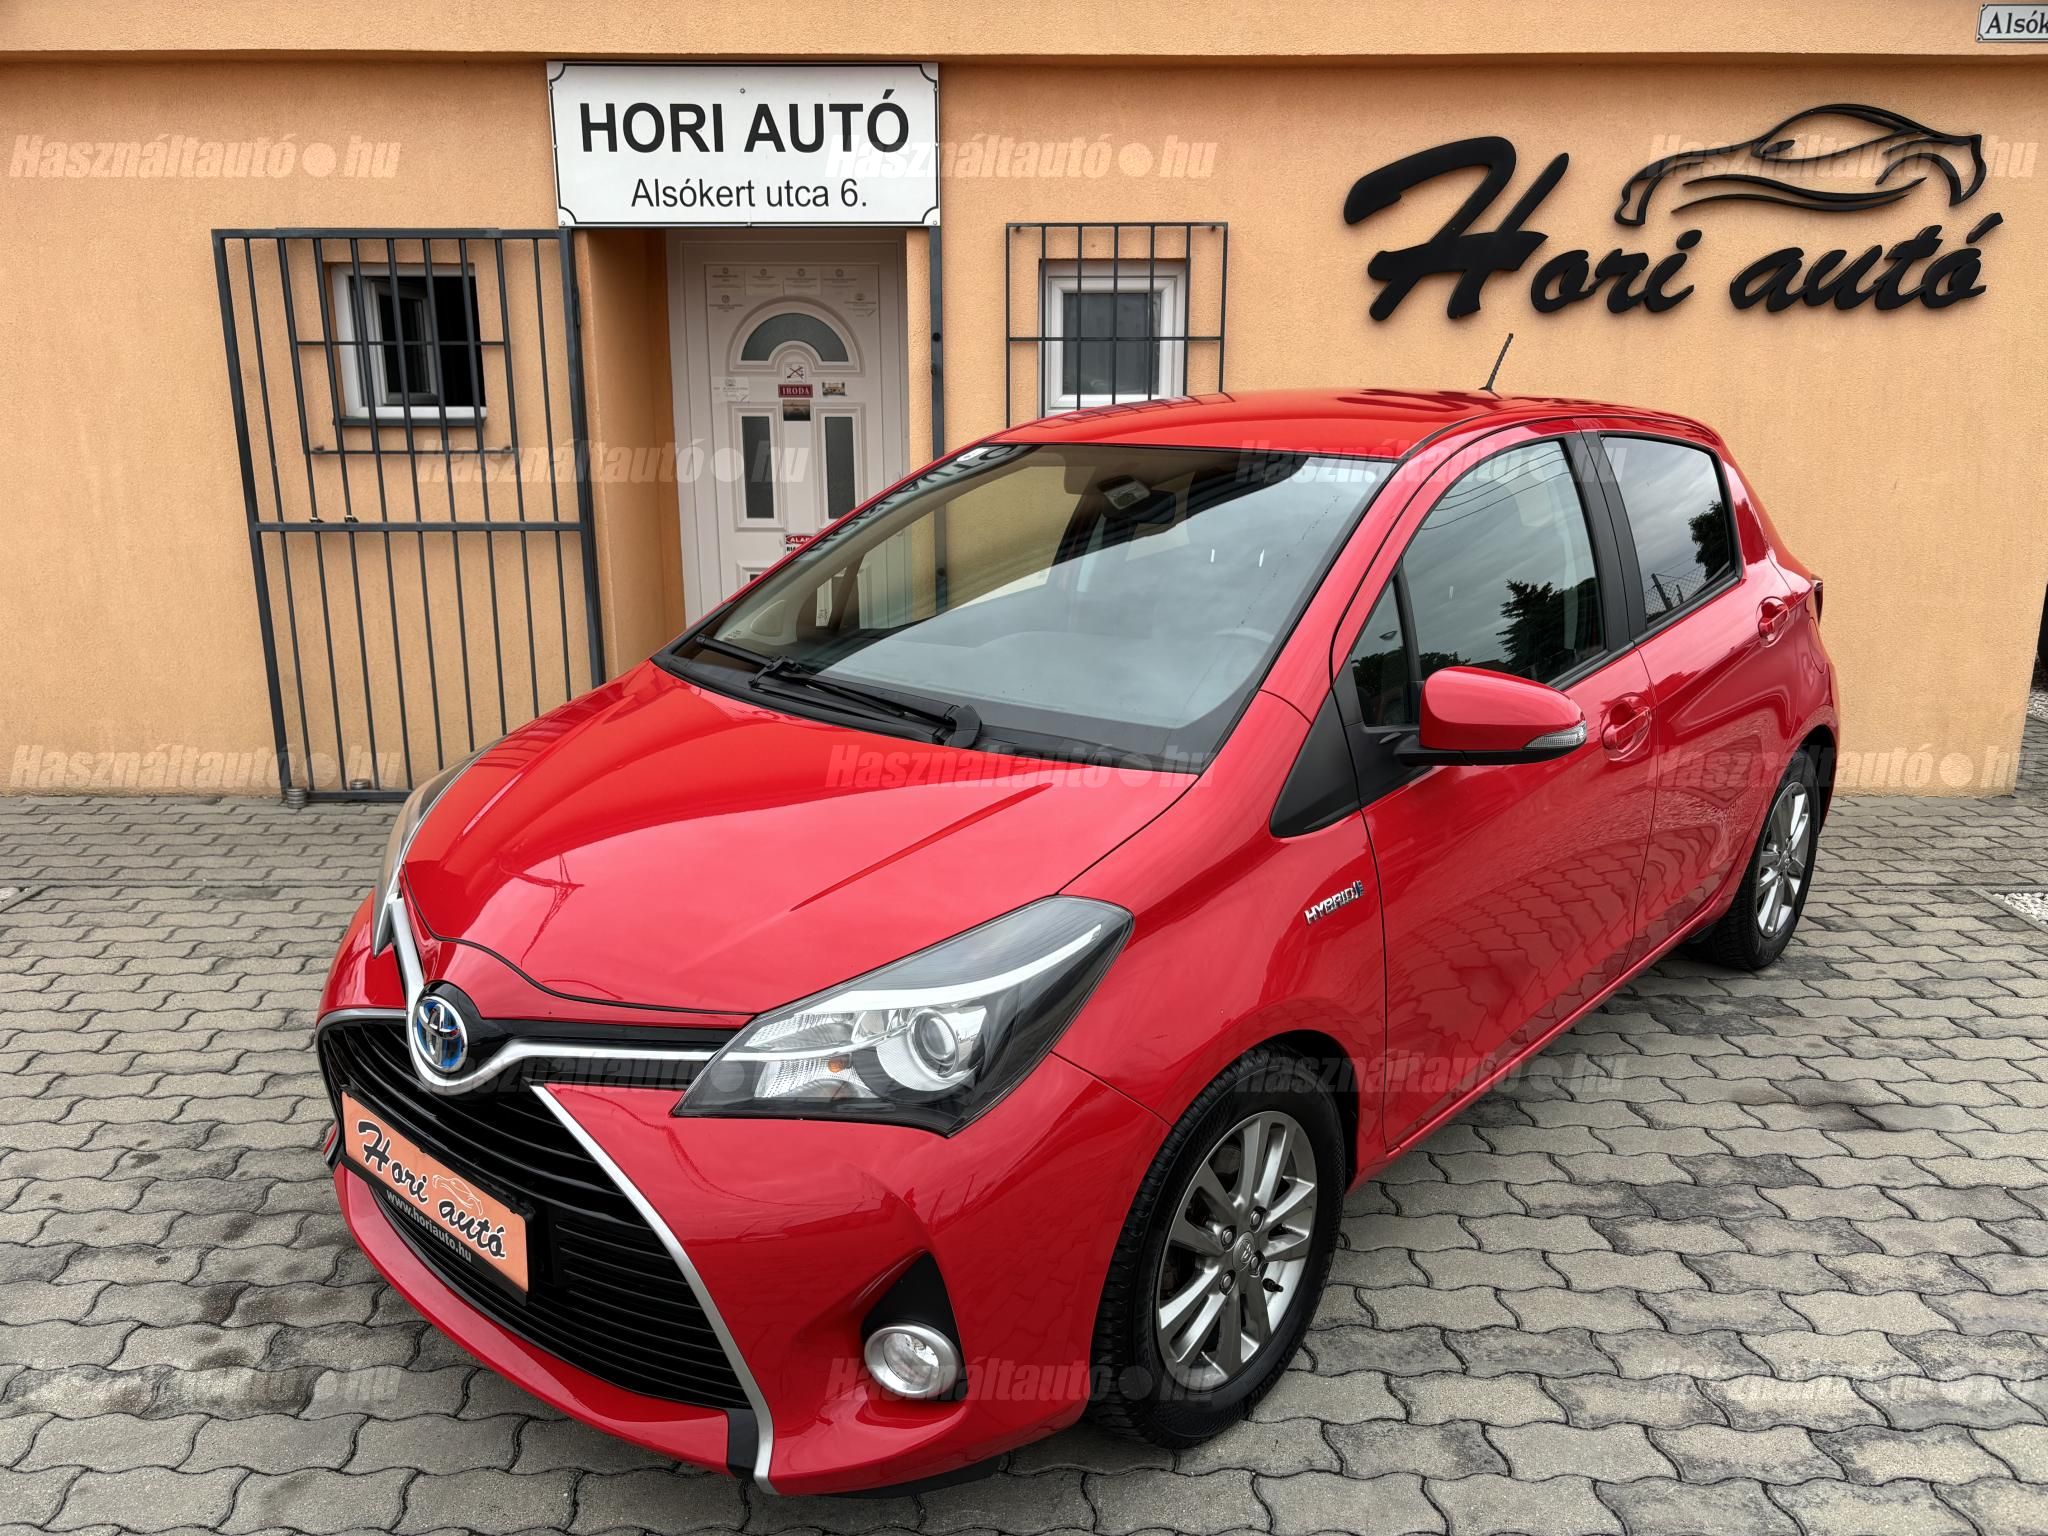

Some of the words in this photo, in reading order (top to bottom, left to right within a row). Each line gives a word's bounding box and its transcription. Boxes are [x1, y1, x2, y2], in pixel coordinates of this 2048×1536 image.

[579, 102, 725, 154] HORI
[743, 88, 910, 154] AUTÓ
[630, 177, 756, 208] Alsókert
[765, 179, 830, 208] utca
[839, 177, 868, 208] 6.
[1343, 135, 1704, 321] Hori
[1729, 211, 2004, 314] autó
[782, 387, 810, 395] IRODA
[1304, 887, 1355, 925] HYBRID
[357, 1119, 429, 1205] Hori
[438, 1198, 507, 1260] autó
[386, 1189, 472, 1263] www.horiauto.hu
